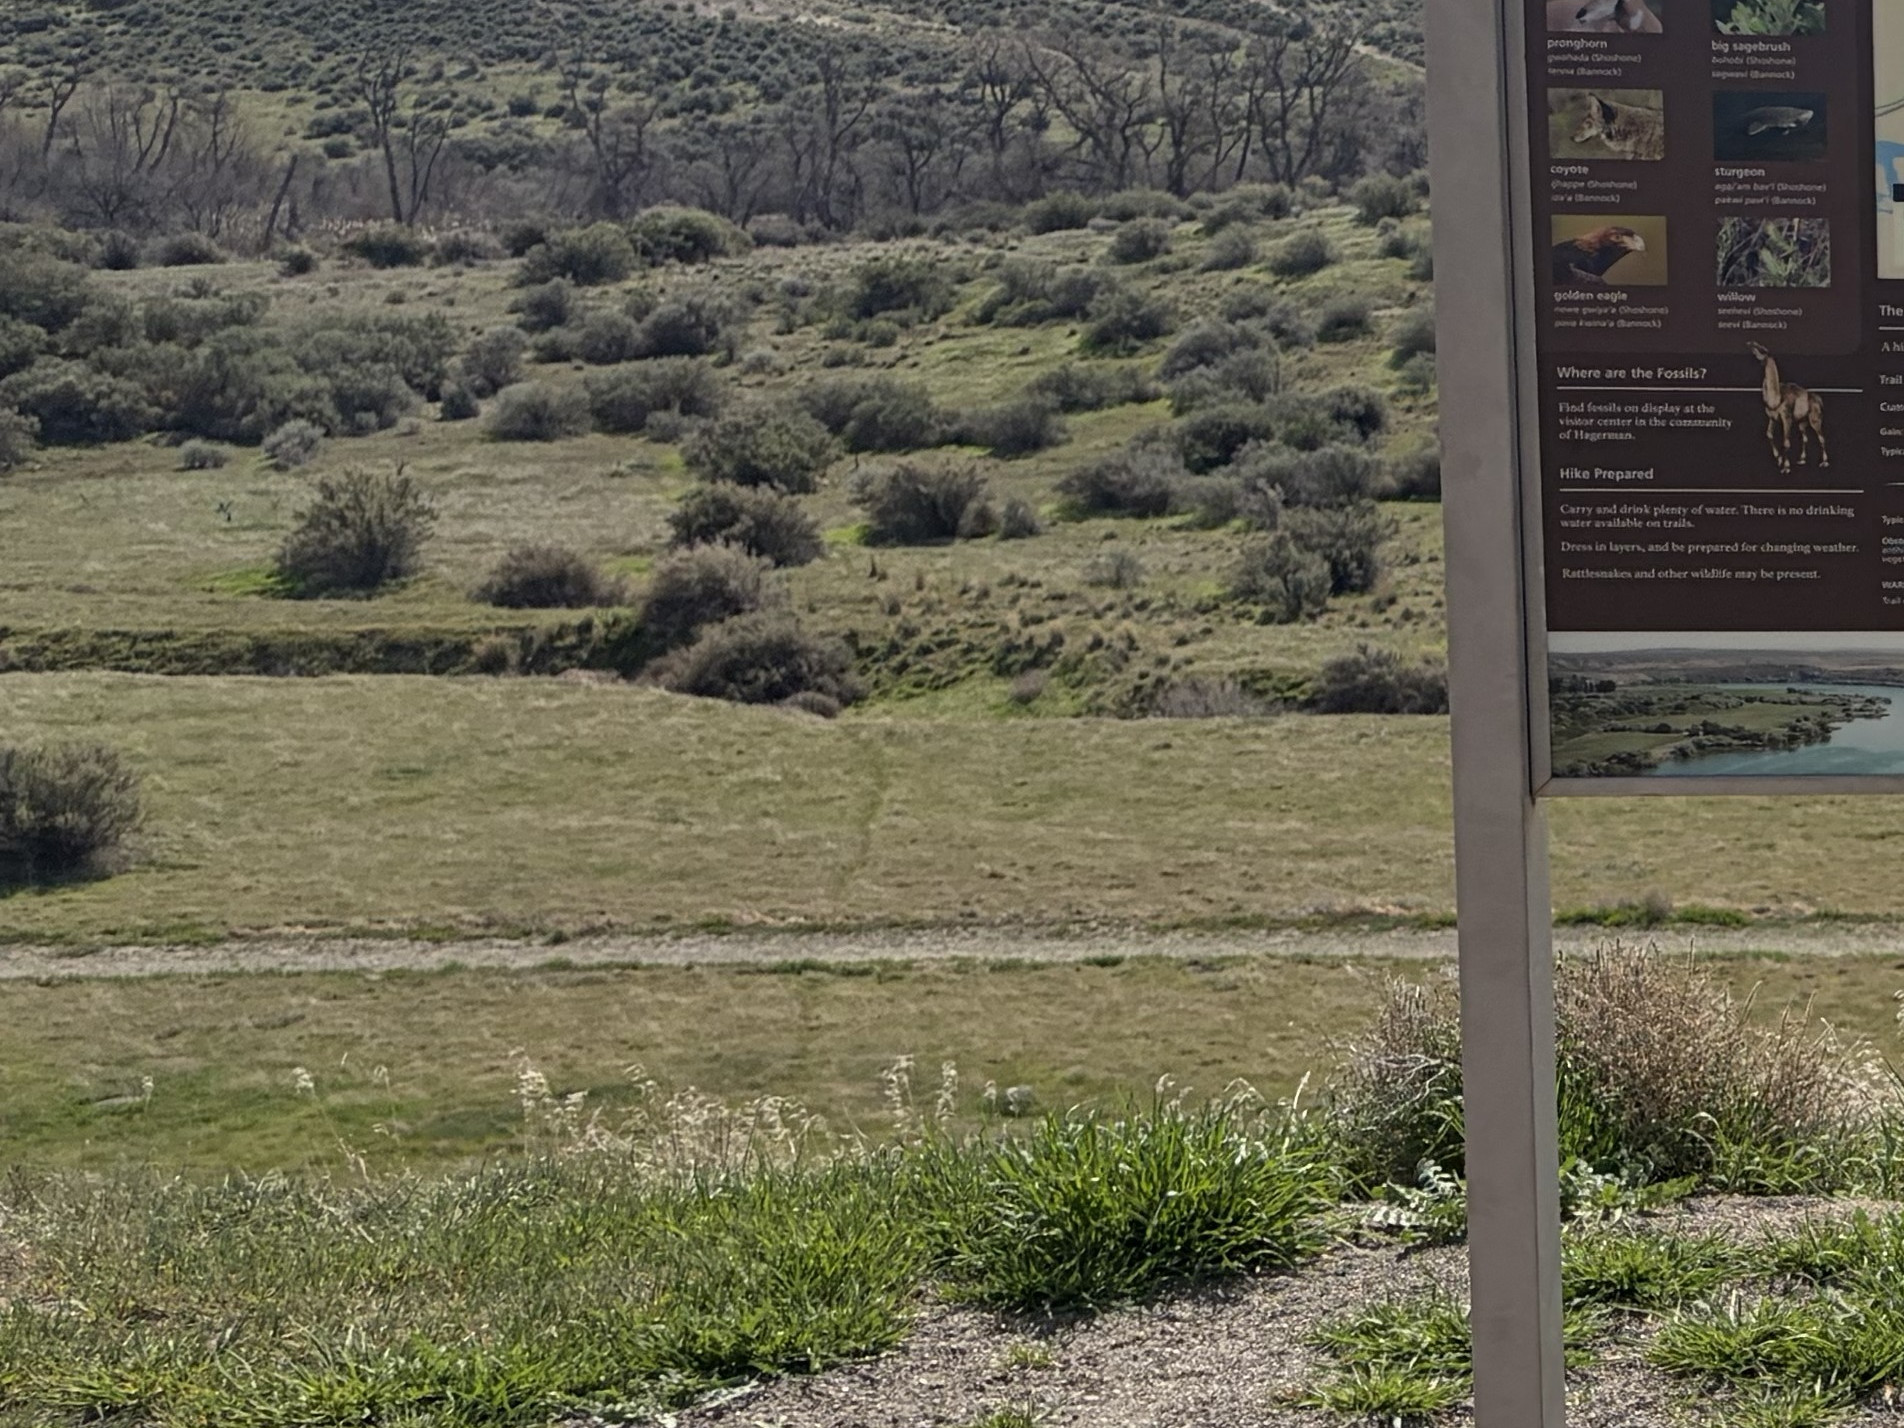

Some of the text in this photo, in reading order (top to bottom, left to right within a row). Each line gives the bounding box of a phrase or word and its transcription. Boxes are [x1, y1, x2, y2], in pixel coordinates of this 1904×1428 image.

[1546, 37, 1608, 53] pronghorn
[1711, 40, 1791, 55] big sagebrush
[1550, 164, 1590, 178] coyote
[1714, 167, 1766, 180] sturgeon
[1554, 289, 1628, 304] golden eagle
[1717, 291, 1756, 302] willow
[1878, 305, 1904, 317] The
[1882, 341, 1890, 352] A
[1556, 366, 1707, 379] Where are the Fossils?
[1878, 375, 1902, 385] Trail
[1559, 467, 1654, 482] Hike Prepared
[1560, 541, 1860, 556] Dress in layers, and be prepared for changing weather.
[1562, 568, 1822, 582] Rattlesnakes and other wildlife may be present.
